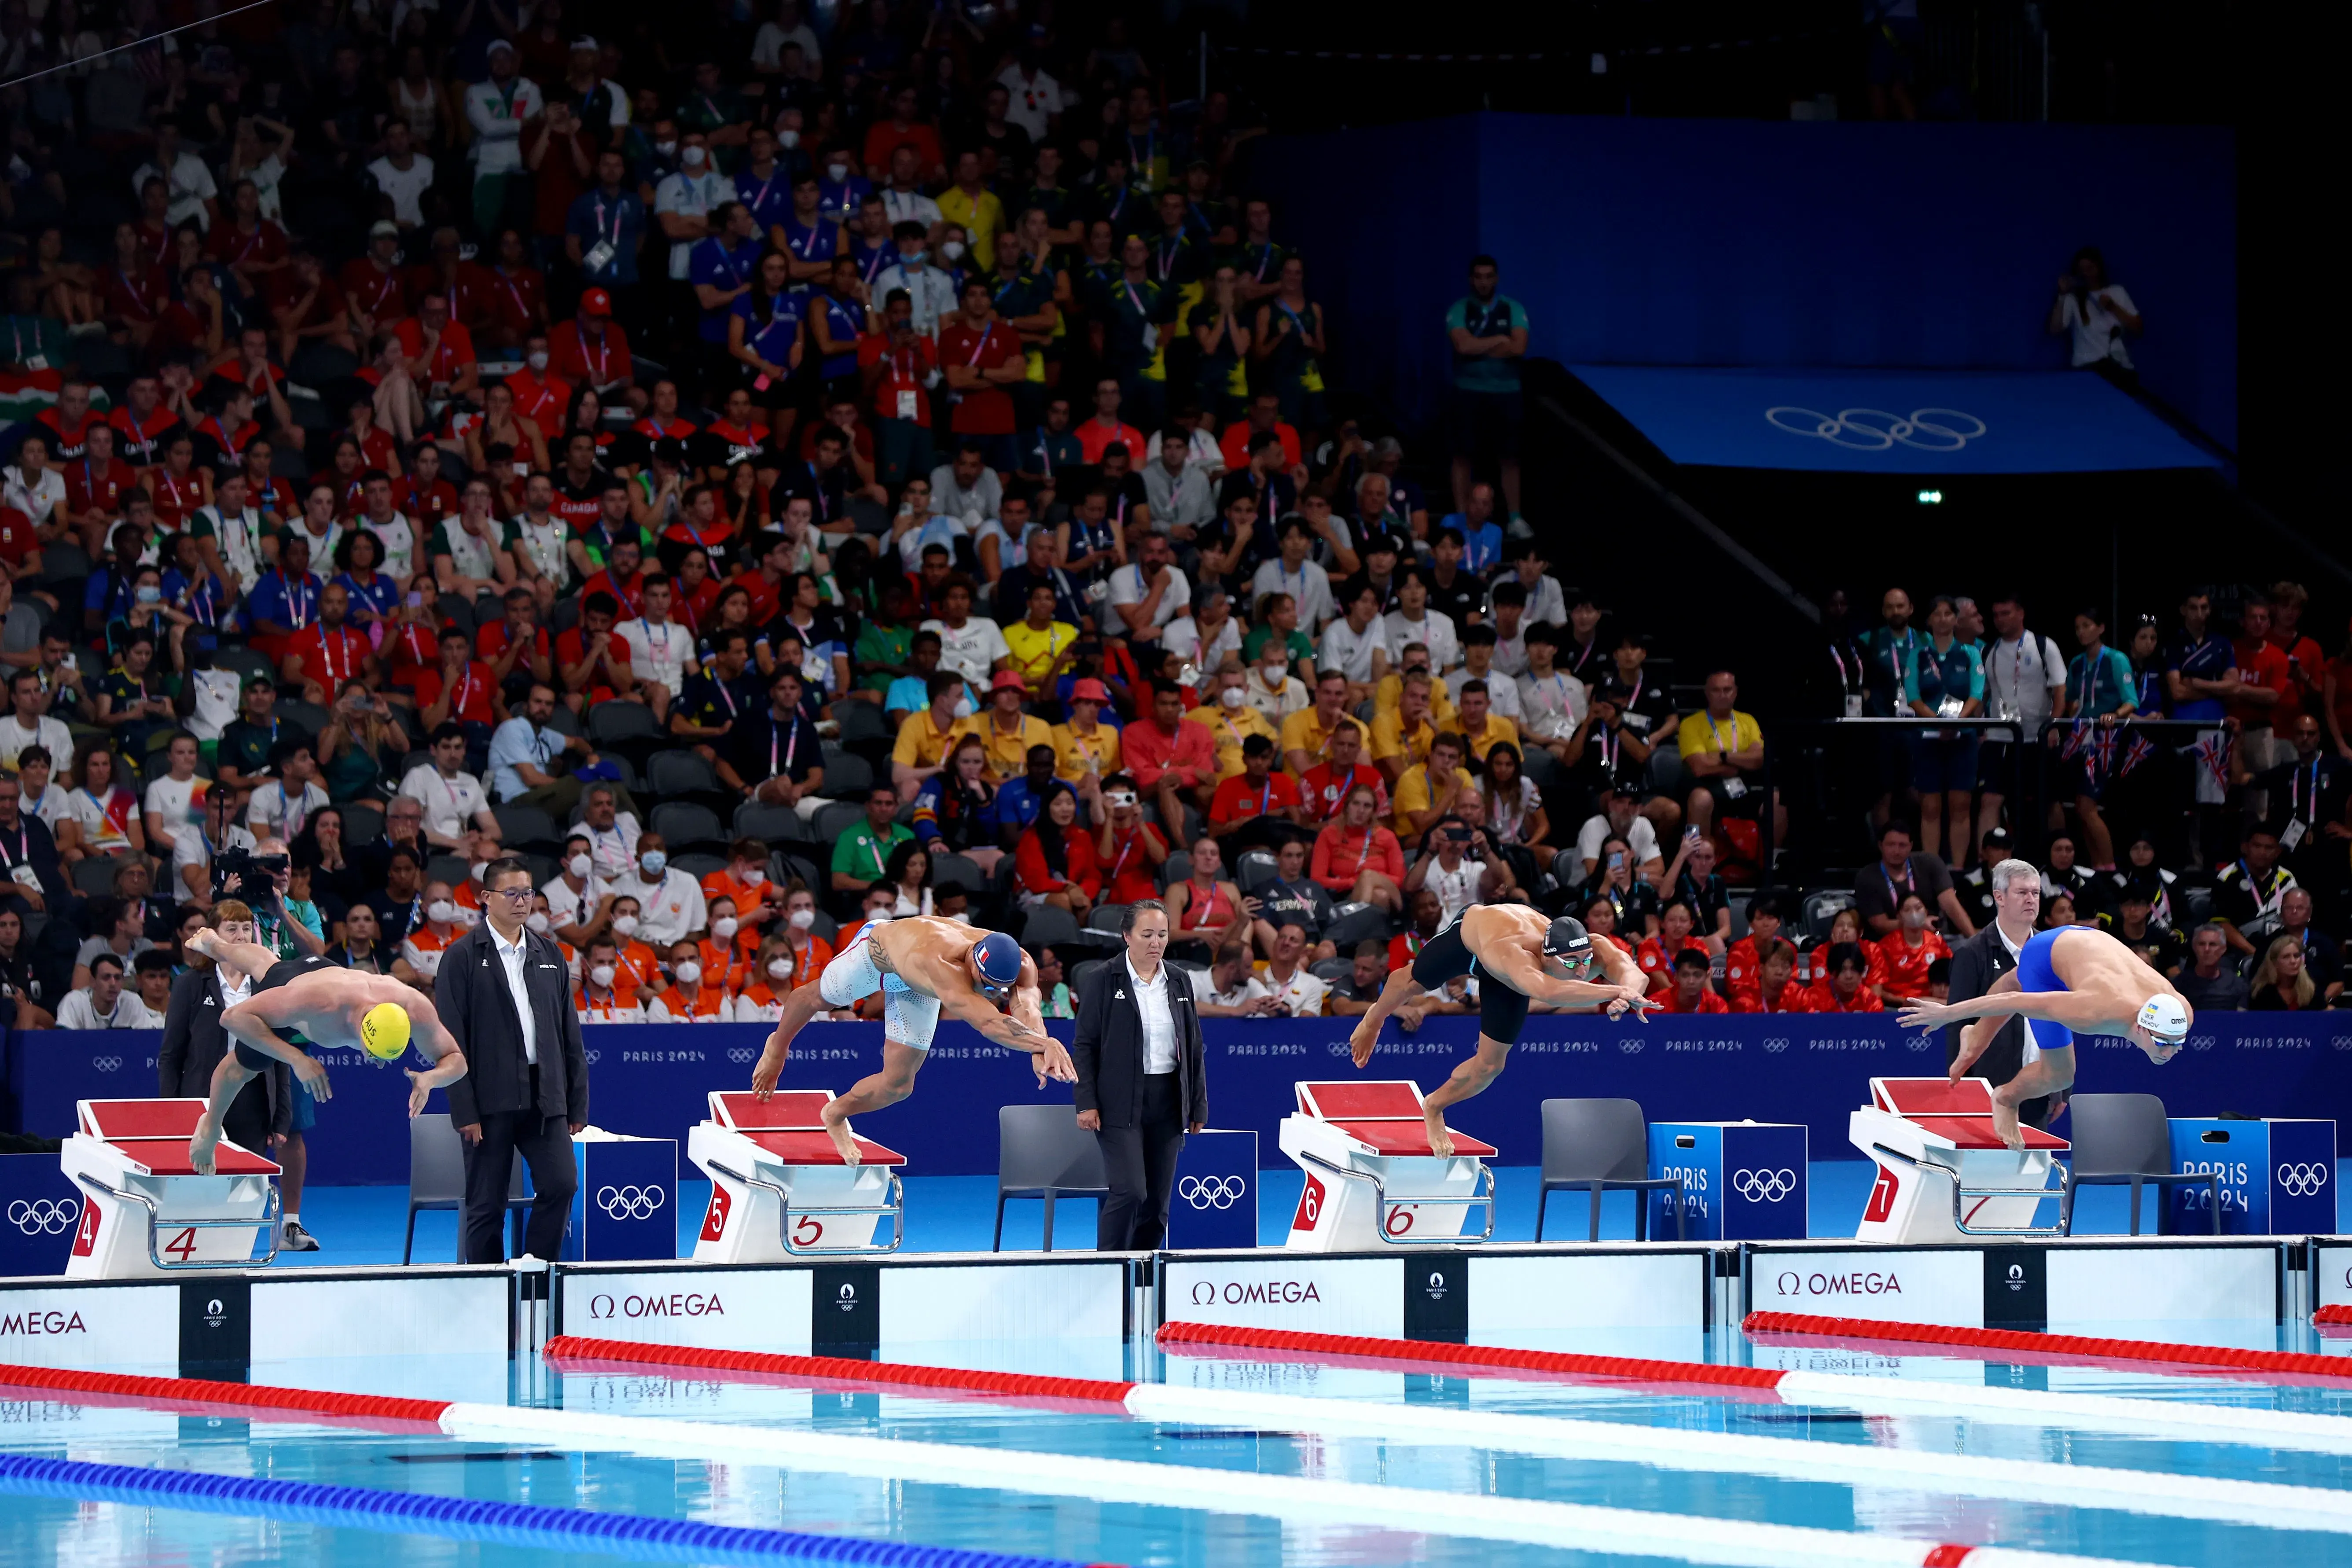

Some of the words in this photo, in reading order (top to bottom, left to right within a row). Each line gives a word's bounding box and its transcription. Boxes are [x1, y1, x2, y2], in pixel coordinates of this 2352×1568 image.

[561, 502, 599, 514] CANADA
[1569, 937, 1589, 947] arena
[365, 1019, 377, 1037] AUS
[973, 1047, 1011, 1058] 2024
[1271, 1044, 1307, 1055] 2024
[1417, 1043, 1453, 1054] 2024
[1563, 1042, 1599, 1053] 2024
[1707, 1040, 1743, 1051] 2024
[1851, 1039, 1886, 1050] 2024
[2276, 1037, 2311, 1048] 2024
[668, 1050, 706, 1062] 2024
[821, 1049, 859, 1061] 2024
[1305, 1186, 1317, 1222] 6
[1664, 1193, 1708, 1219] 2024
[1878, 1179, 1890, 1213] 7
[2184, 1188, 2249, 1212] 2024
[711, 1197, 723, 1233] 5
[1386, 1205, 1414, 1236] 6
[1963, 1196, 1991, 1226] 7
[81, 1212, 92, 1248] 4
[793, 1215, 823, 1246] 5
[165, 1228, 197, 1261] 4
[1224, 1282, 1321, 1304] OMEGA
[1808, 1272, 1902, 1295] OMEGA
[624, 1293, 724, 1318] OMEGA
[0, 1310, 87, 1336] MEGA
